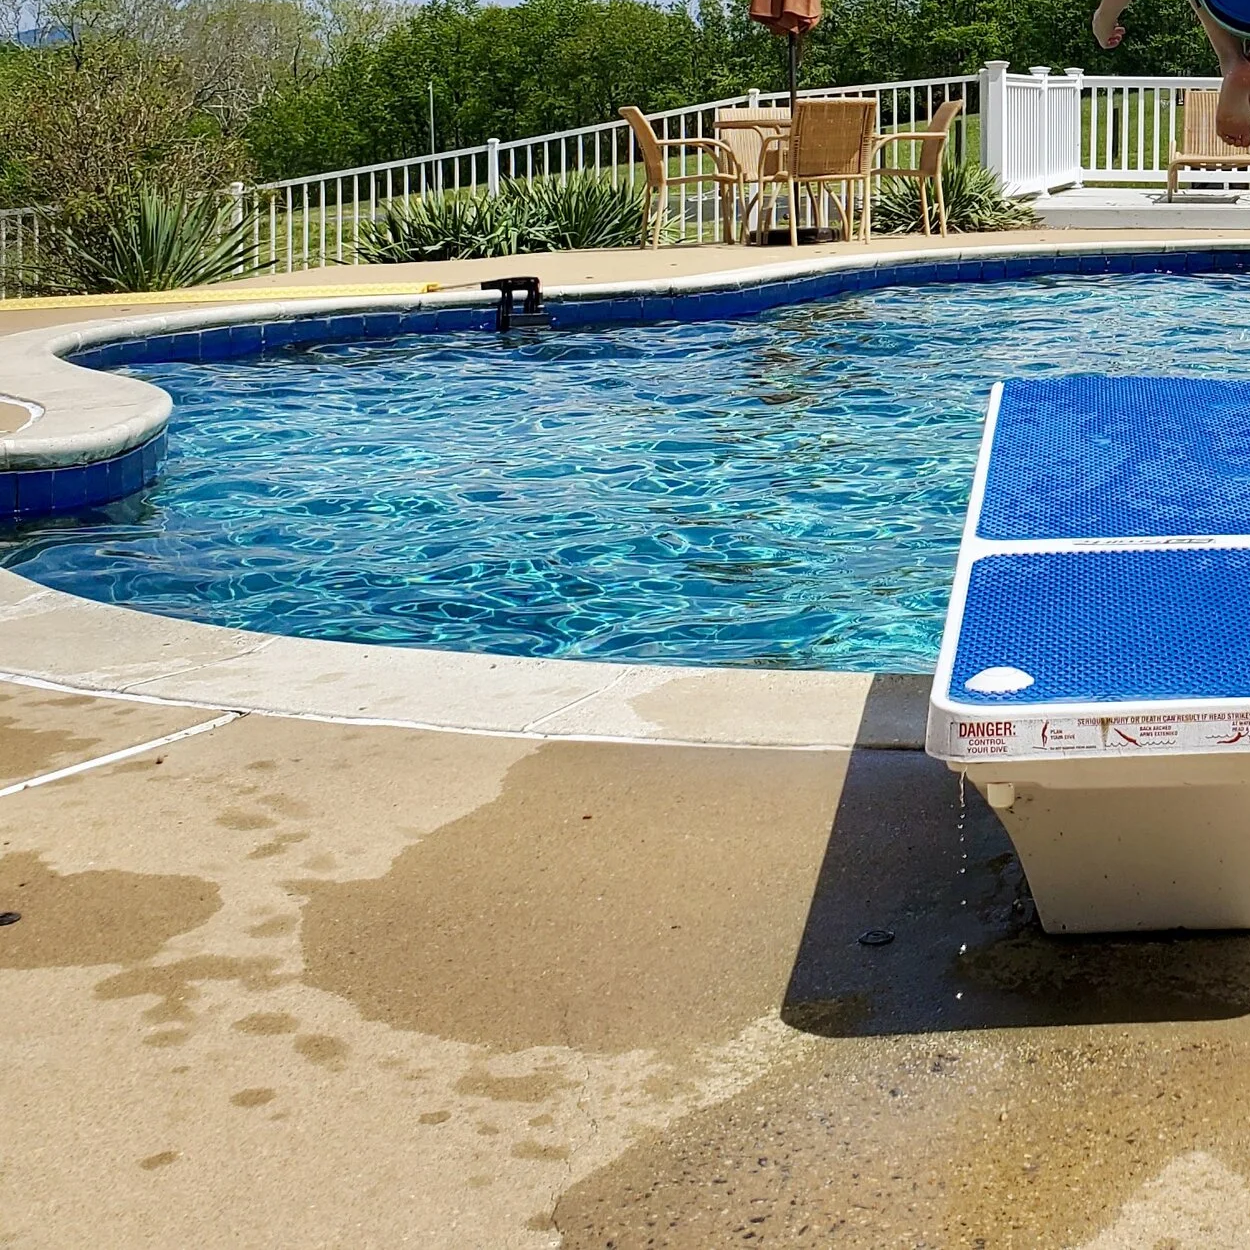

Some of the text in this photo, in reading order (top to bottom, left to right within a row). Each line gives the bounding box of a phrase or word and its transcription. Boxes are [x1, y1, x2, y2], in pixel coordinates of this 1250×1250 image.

[1130, 716, 1139, 724] OR
[1141, 715, 1161, 723] DEATH
[959, 722, 1016, 737] DANGER:
[968, 738, 1006, 746] CONTROL
[967, 746, 988, 754] YOUR
